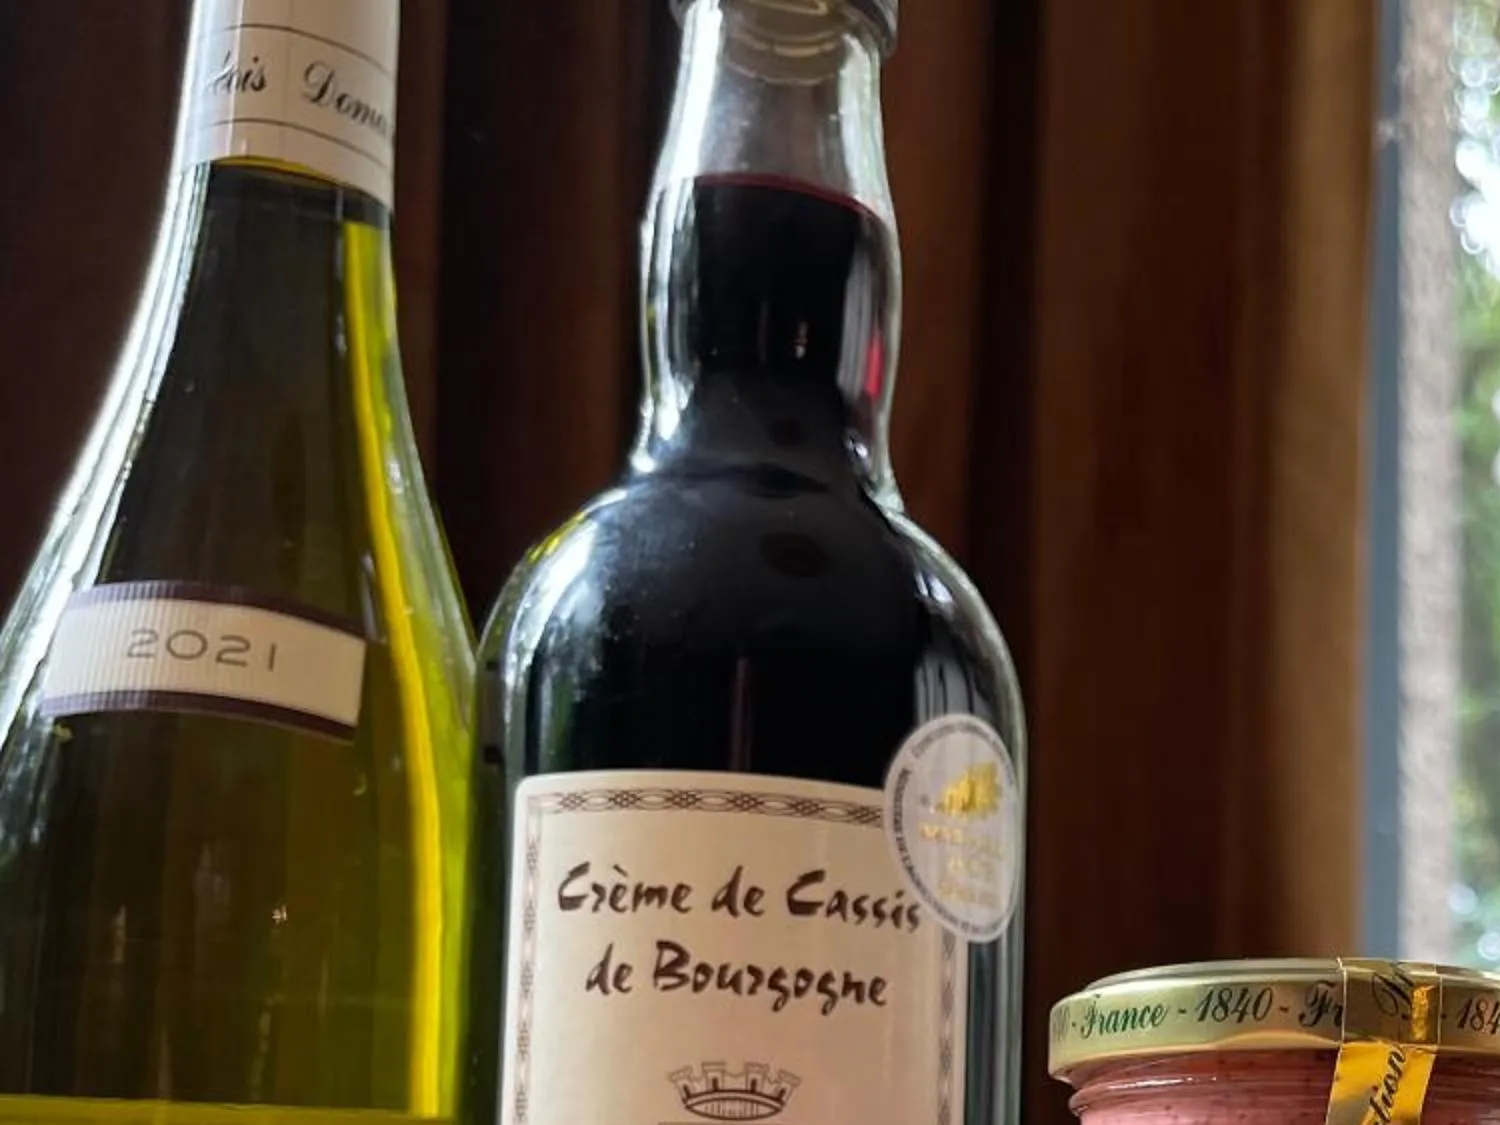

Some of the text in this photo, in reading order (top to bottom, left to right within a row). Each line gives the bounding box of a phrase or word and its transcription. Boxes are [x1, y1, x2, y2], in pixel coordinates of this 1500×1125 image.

[127, 628, 278, 672] 2021
[556, 861, 692, 914] Crème
[711, 865, 765, 917] de
[785, 869, 921, 933] Cassis
[585, 940, 888, 1015] de Bourgogne
[1081, 994, 1169, 1039] France
[1196, 986, 1274, 1025] 1840
